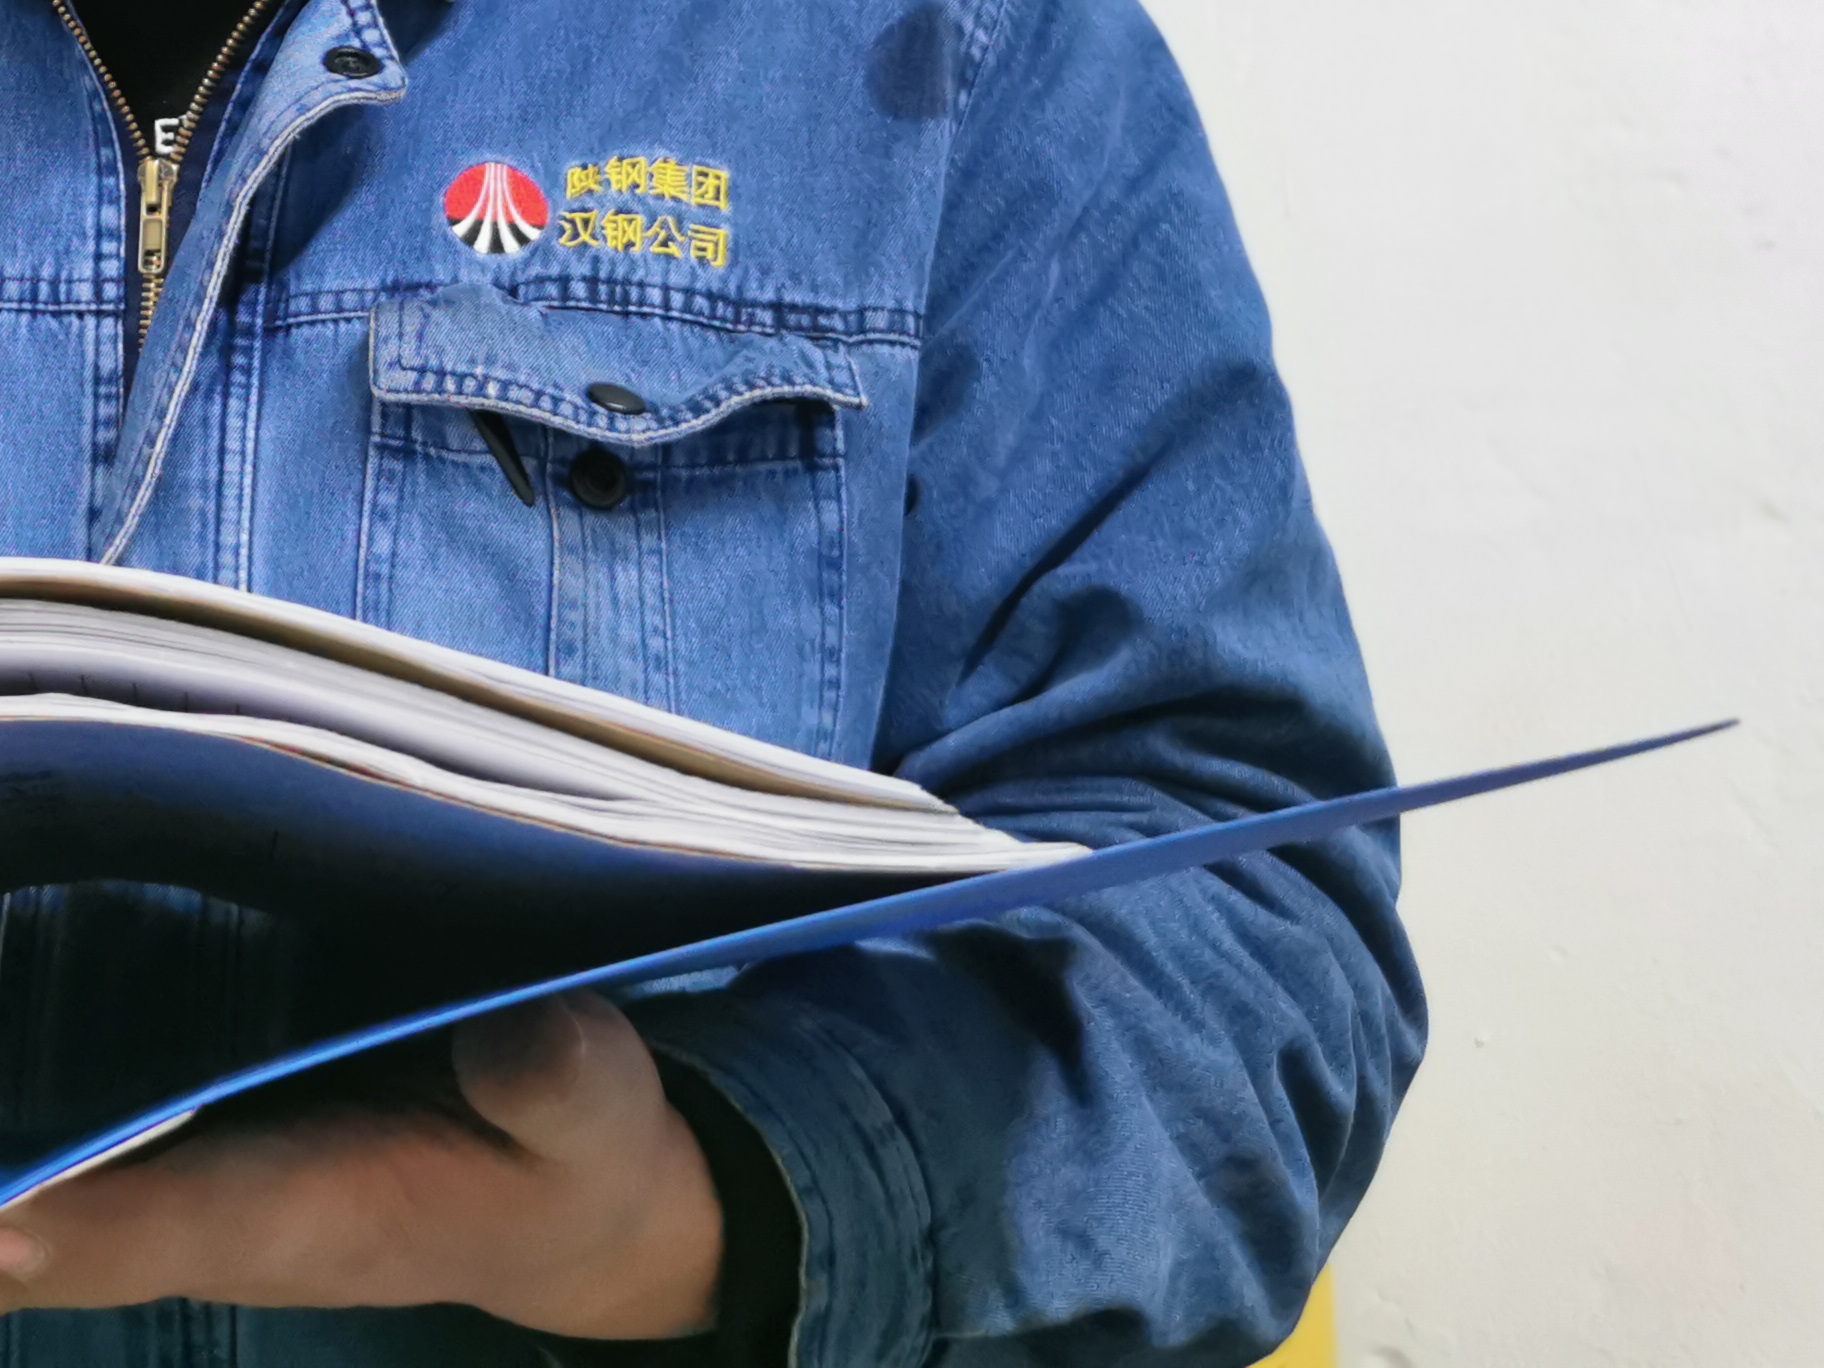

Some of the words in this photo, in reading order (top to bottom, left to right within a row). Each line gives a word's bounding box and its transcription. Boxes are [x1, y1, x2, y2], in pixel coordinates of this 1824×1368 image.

[566, 156, 729, 210] 陕钢集团
[559, 210, 728, 268] 汉钢公司
